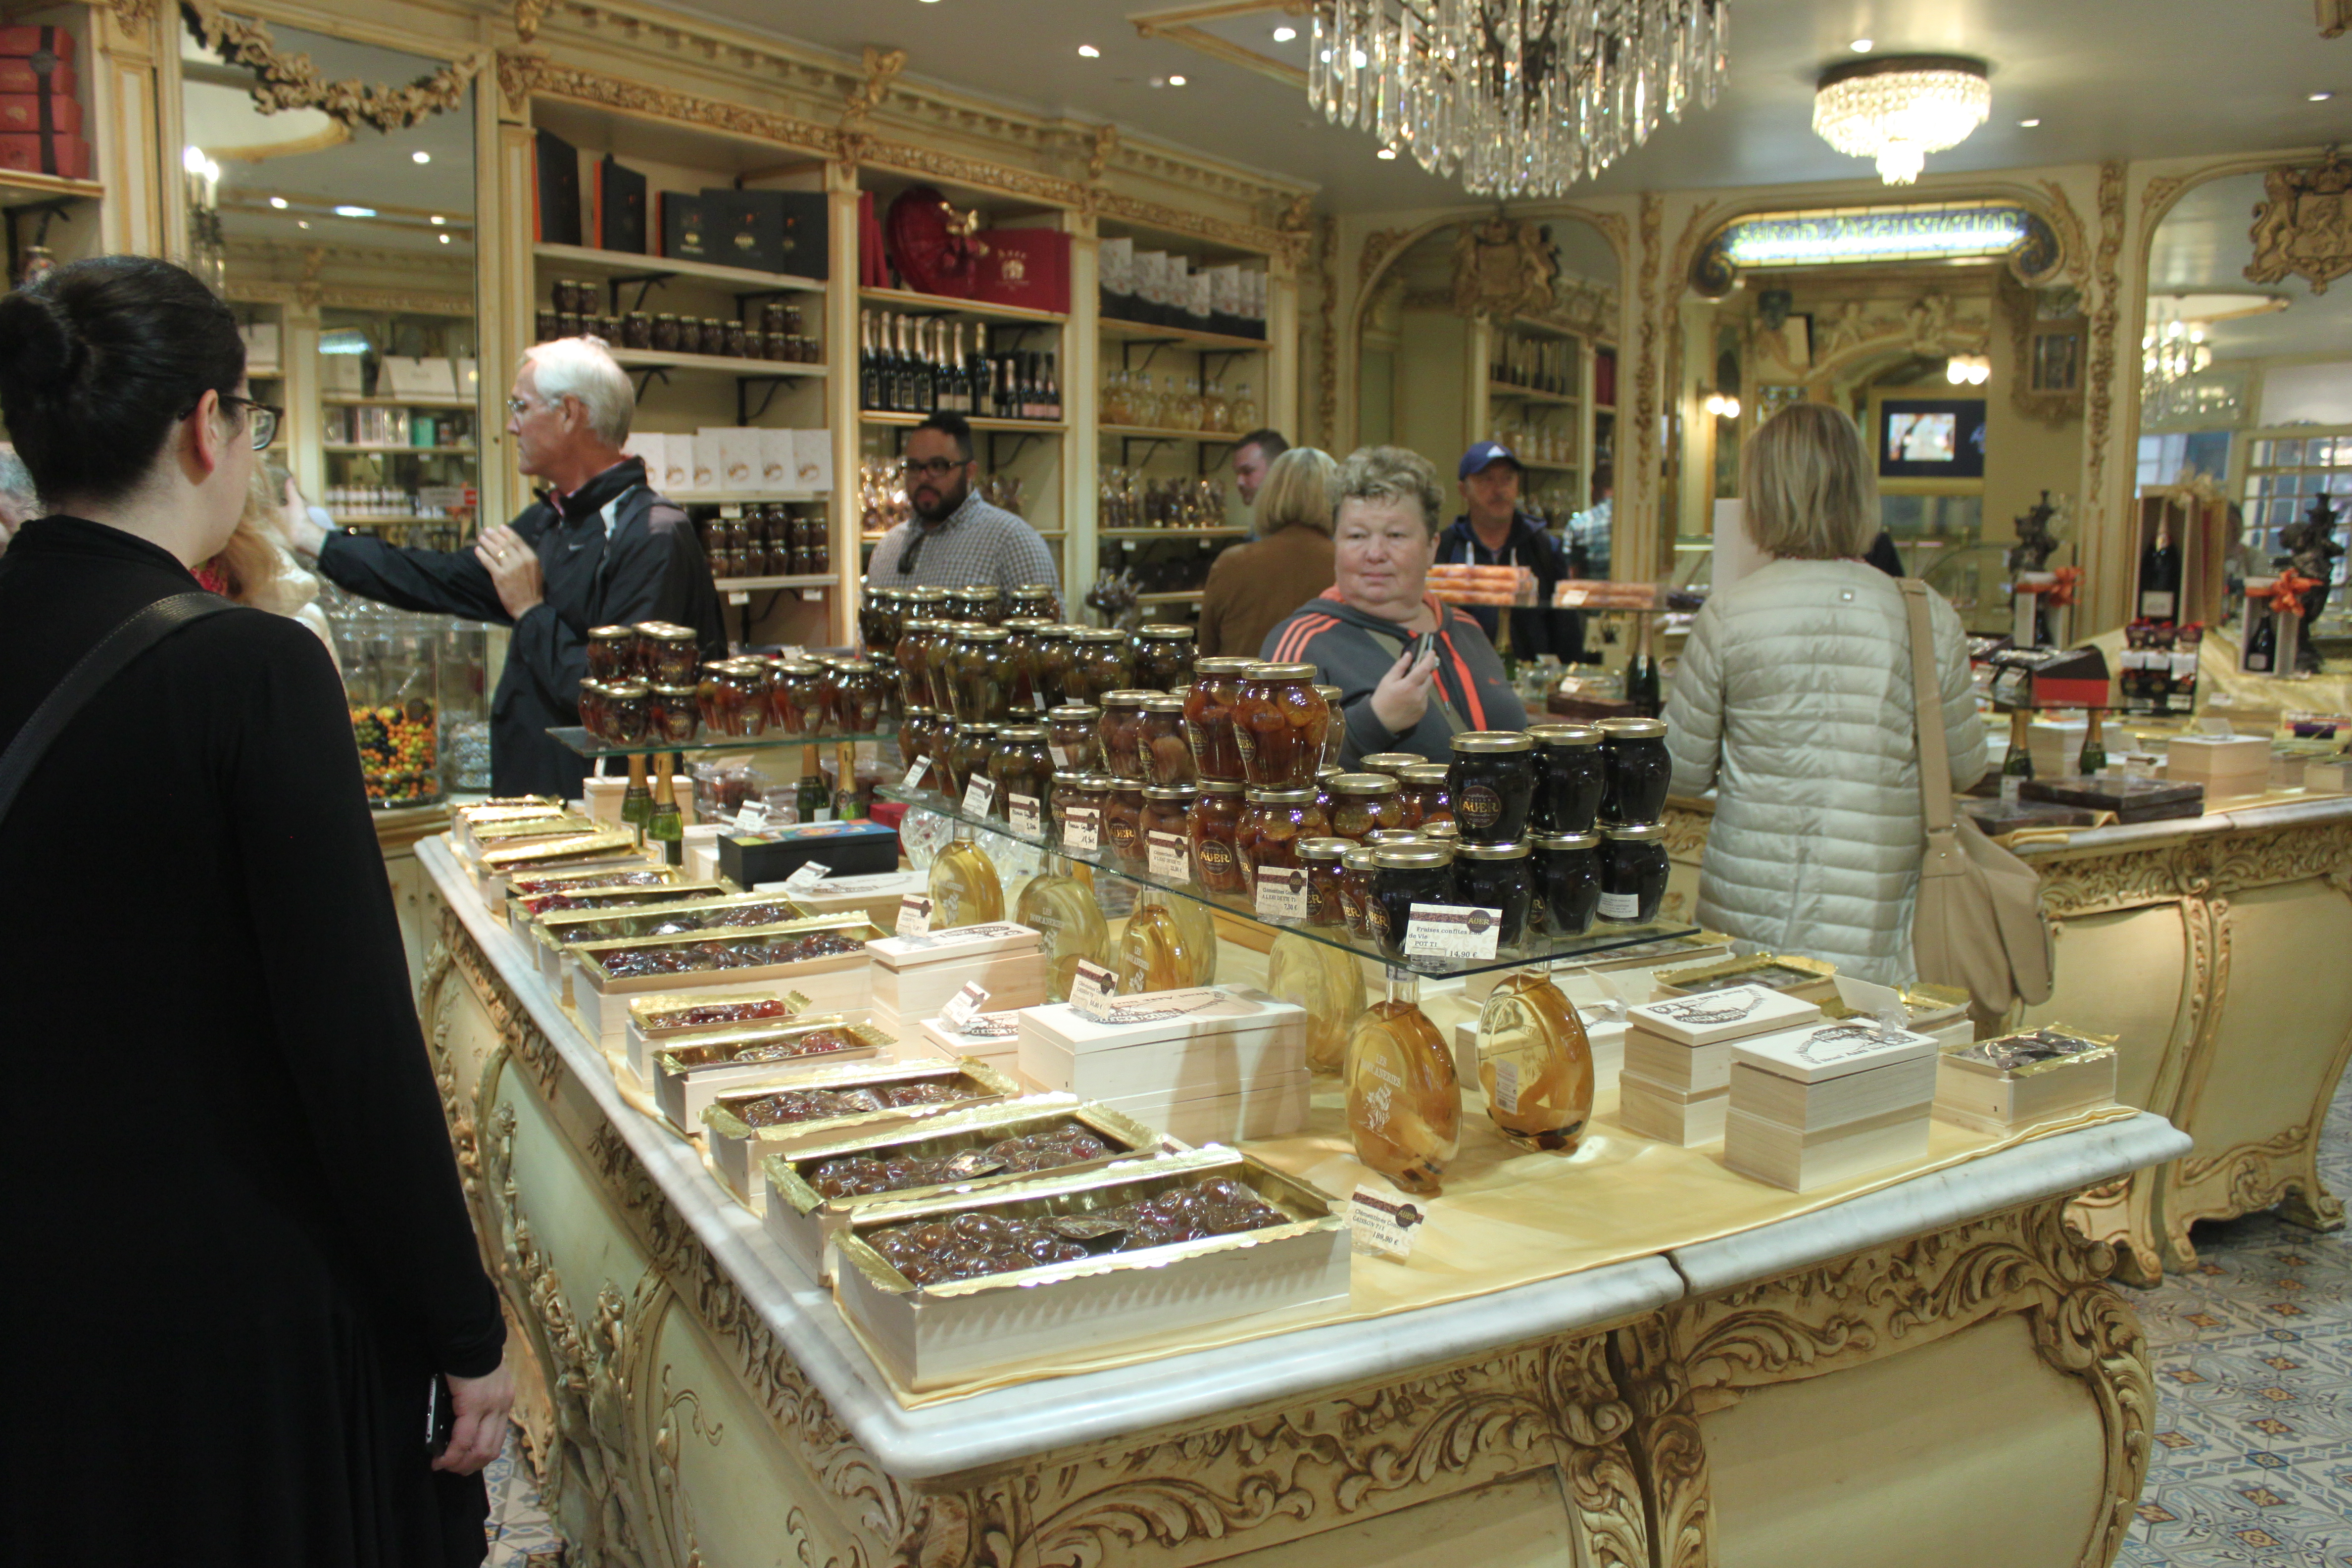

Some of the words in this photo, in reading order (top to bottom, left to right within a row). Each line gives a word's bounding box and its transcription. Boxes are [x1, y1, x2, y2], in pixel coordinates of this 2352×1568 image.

[1190, 734, 1208, 743] UER
[1463, 801, 1499, 813] AUER
[1200, 850, 1230, 863] AUER
[1369, 910, 1388, 927] UER
[1375, 1053, 1387, 1067] LES
[1355, 1209, 1386, 1224] Clémentines
[1397, 1210, 1416, 1221] AUER
[1353, 1216, 1375, 1228] CAISSON
[1372, 1231, 1393, 1243] 189,90
